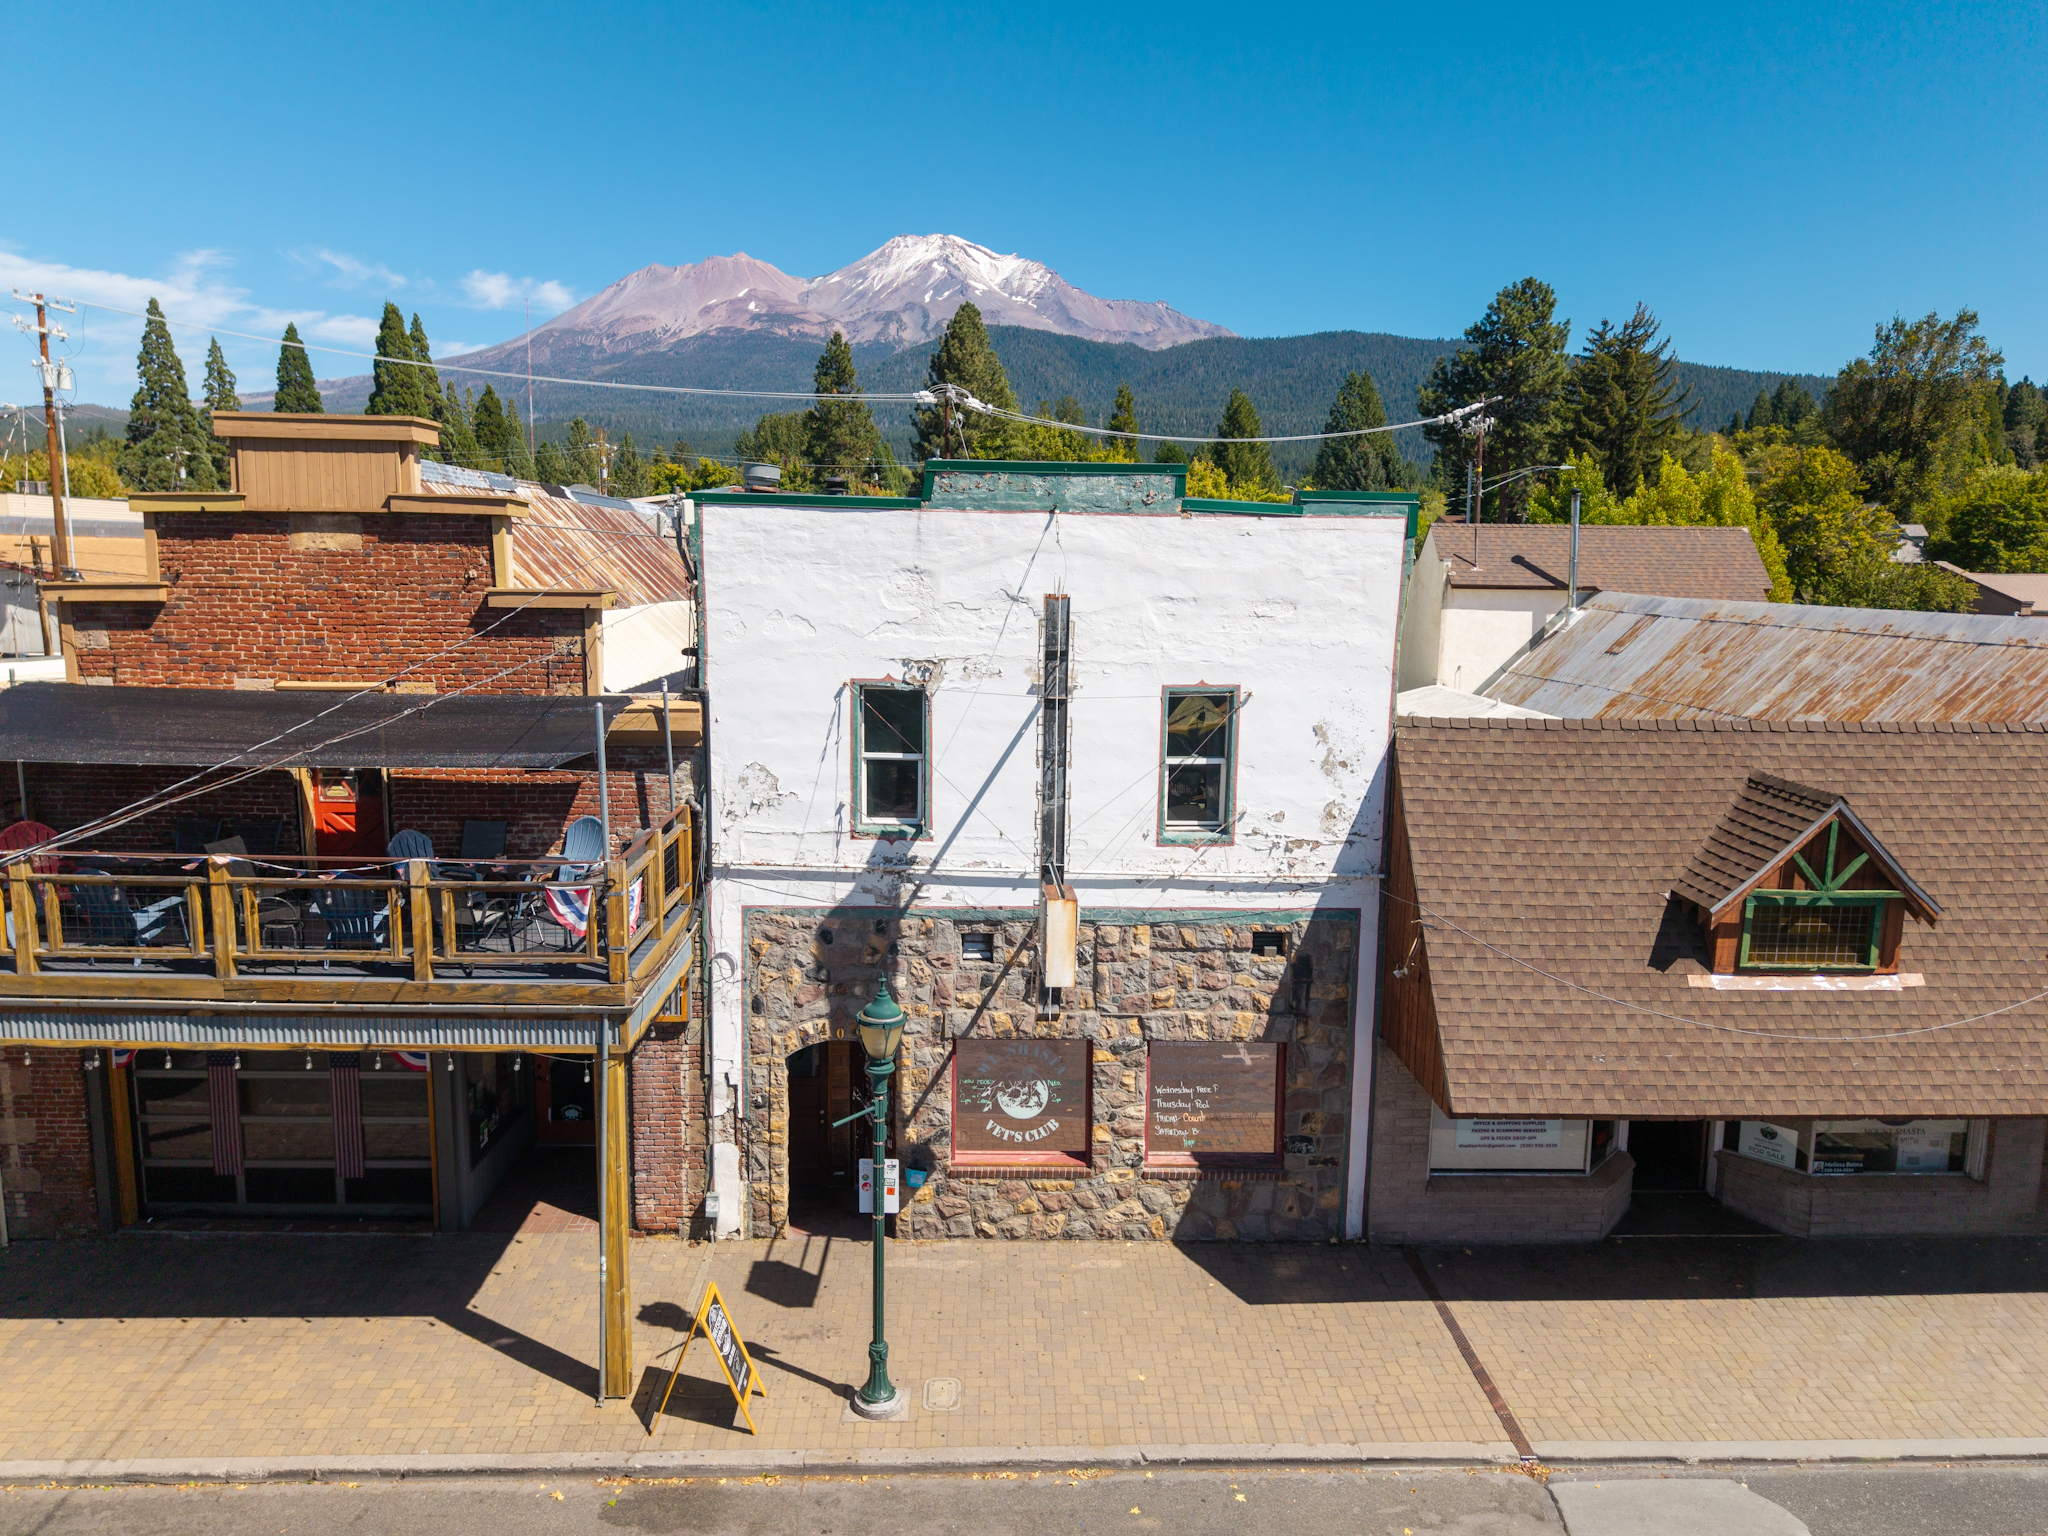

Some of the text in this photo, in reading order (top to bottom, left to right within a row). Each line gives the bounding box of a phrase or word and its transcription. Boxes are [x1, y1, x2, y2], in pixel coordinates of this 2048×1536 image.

[1006, 1043, 1066, 1076] SHASTA
[985, 1118, 1060, 1143] VET'S CLUB
[1748, 1145, 1765, 1156] FOR
[1766, 1150, 1786, 1161] SALE
